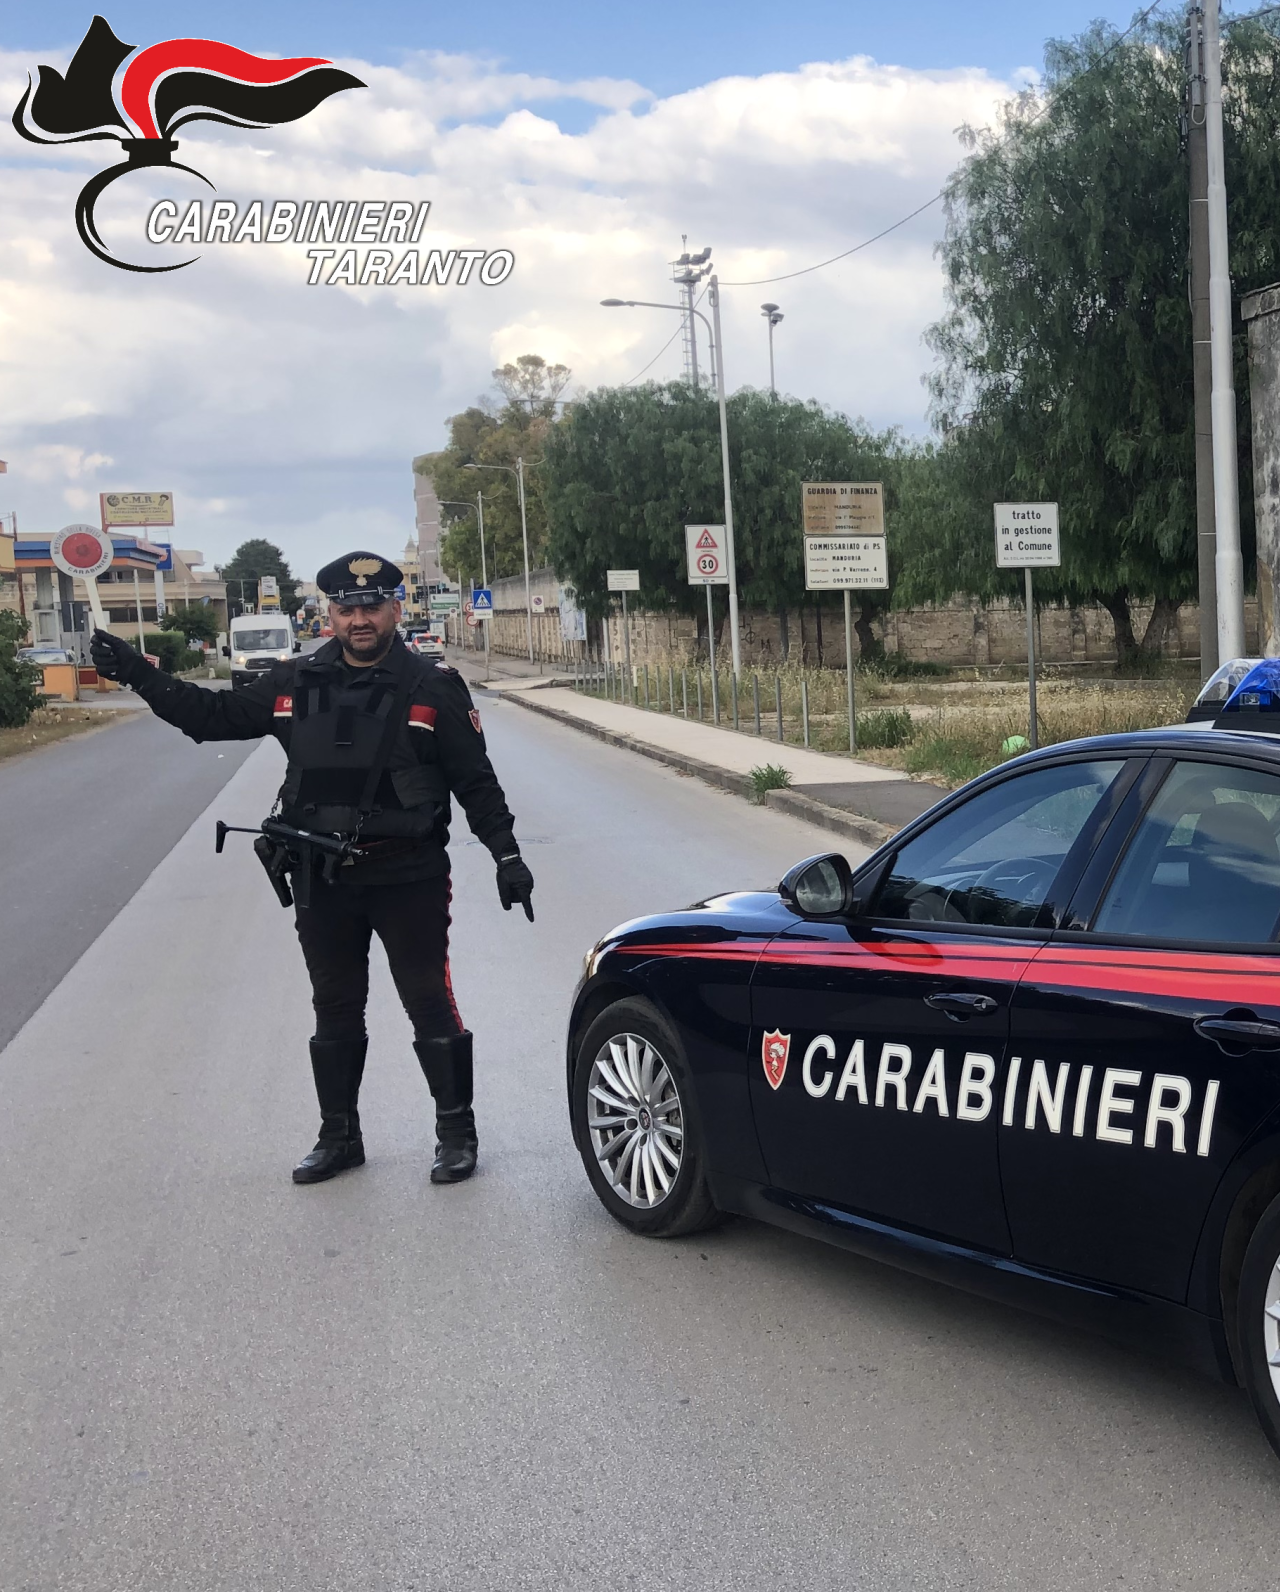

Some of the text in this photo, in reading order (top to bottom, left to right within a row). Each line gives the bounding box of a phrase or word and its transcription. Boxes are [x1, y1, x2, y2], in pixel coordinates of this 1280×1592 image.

[807, 487, 837, 495] GUARDIA
[850, 487, 878, 495] FINANZA
[121, 495, 156, 504] C.M.R.
[1012, 510, 1041, 519] tratto
[1001, 525, 1052, 537] in gestione
[1004, 540, 1052, 551] al Comune
[67, 552, 109, 575] CARABINIERI
[701, 559, 714, 569] 30
[801, 1034, 1220, 1157] CARABINIERI
